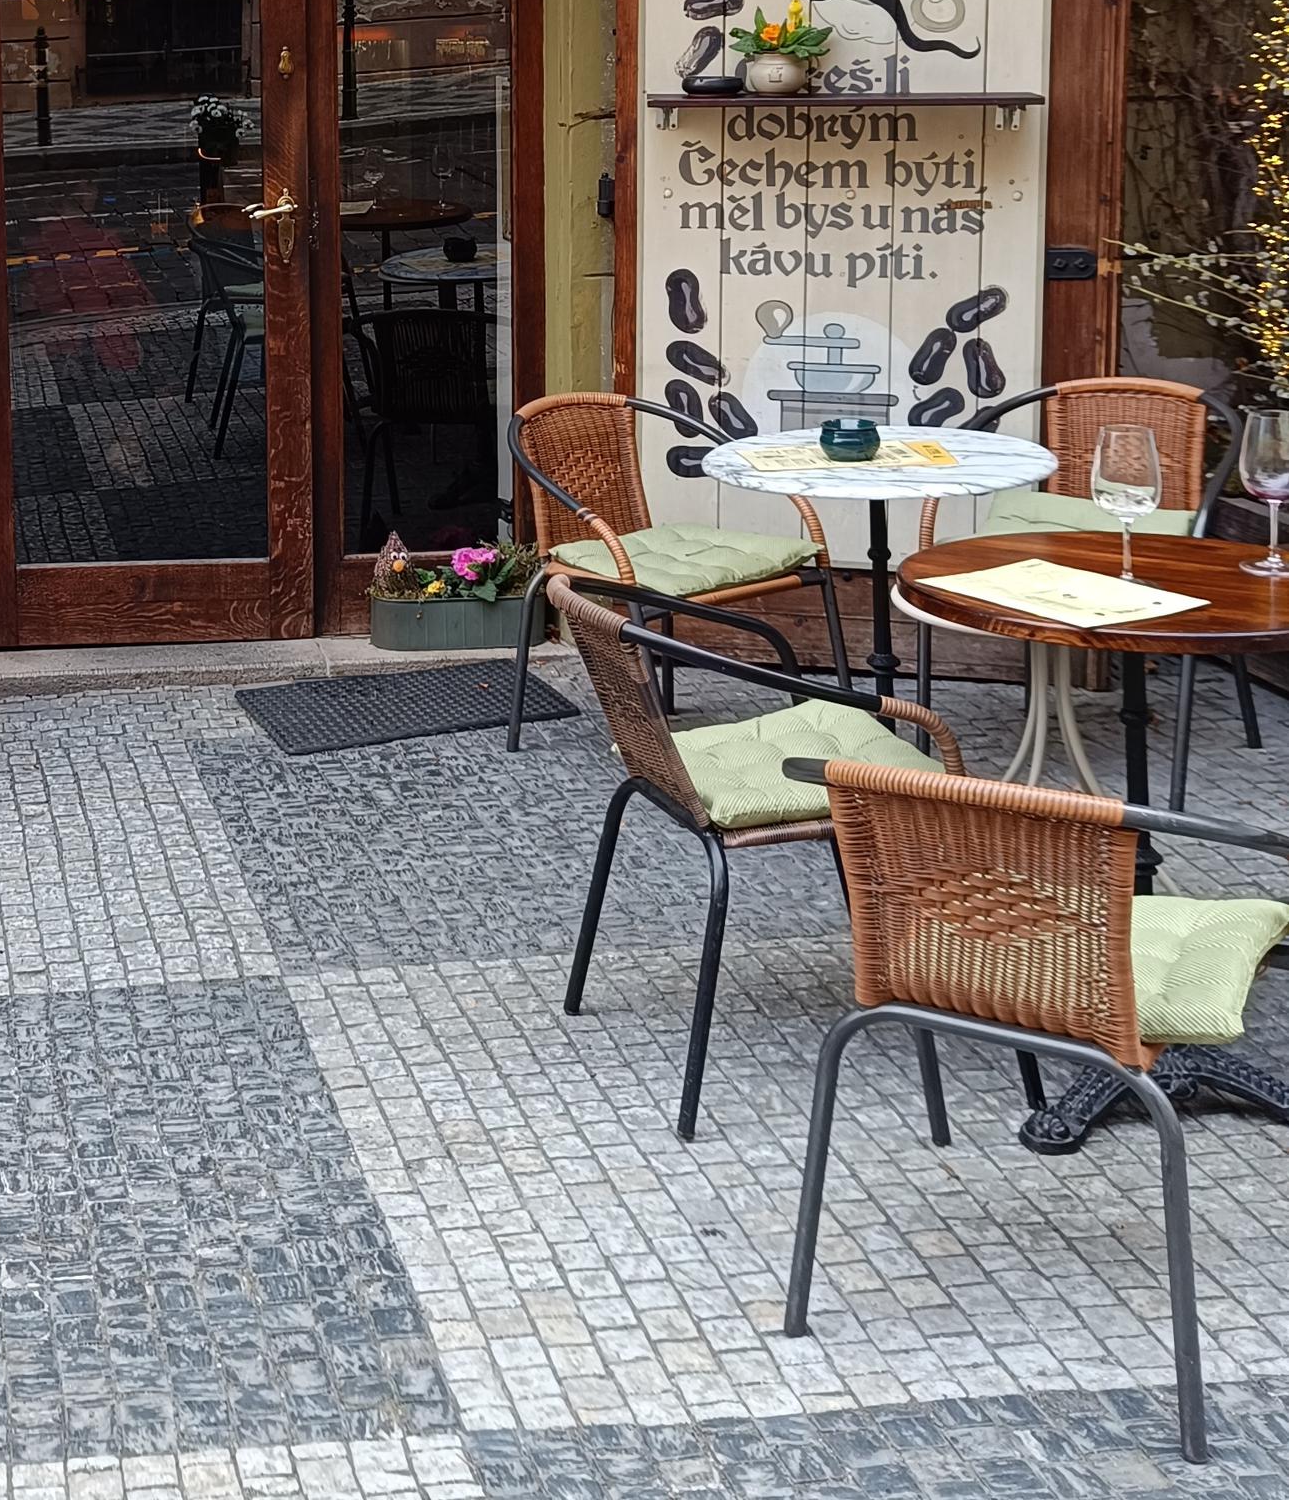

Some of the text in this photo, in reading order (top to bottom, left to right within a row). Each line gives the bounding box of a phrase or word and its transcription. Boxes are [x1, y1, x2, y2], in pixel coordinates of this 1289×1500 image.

[727, 106, 919, 150] dobrým
[678, 140, 988, 197] Čechem býti,
[679, 191, 766, 232] měl
[775, 191, 854, 239] bys
[861, 204, 891, 230] u
[720, 237, 938, 288] kávu píti.
